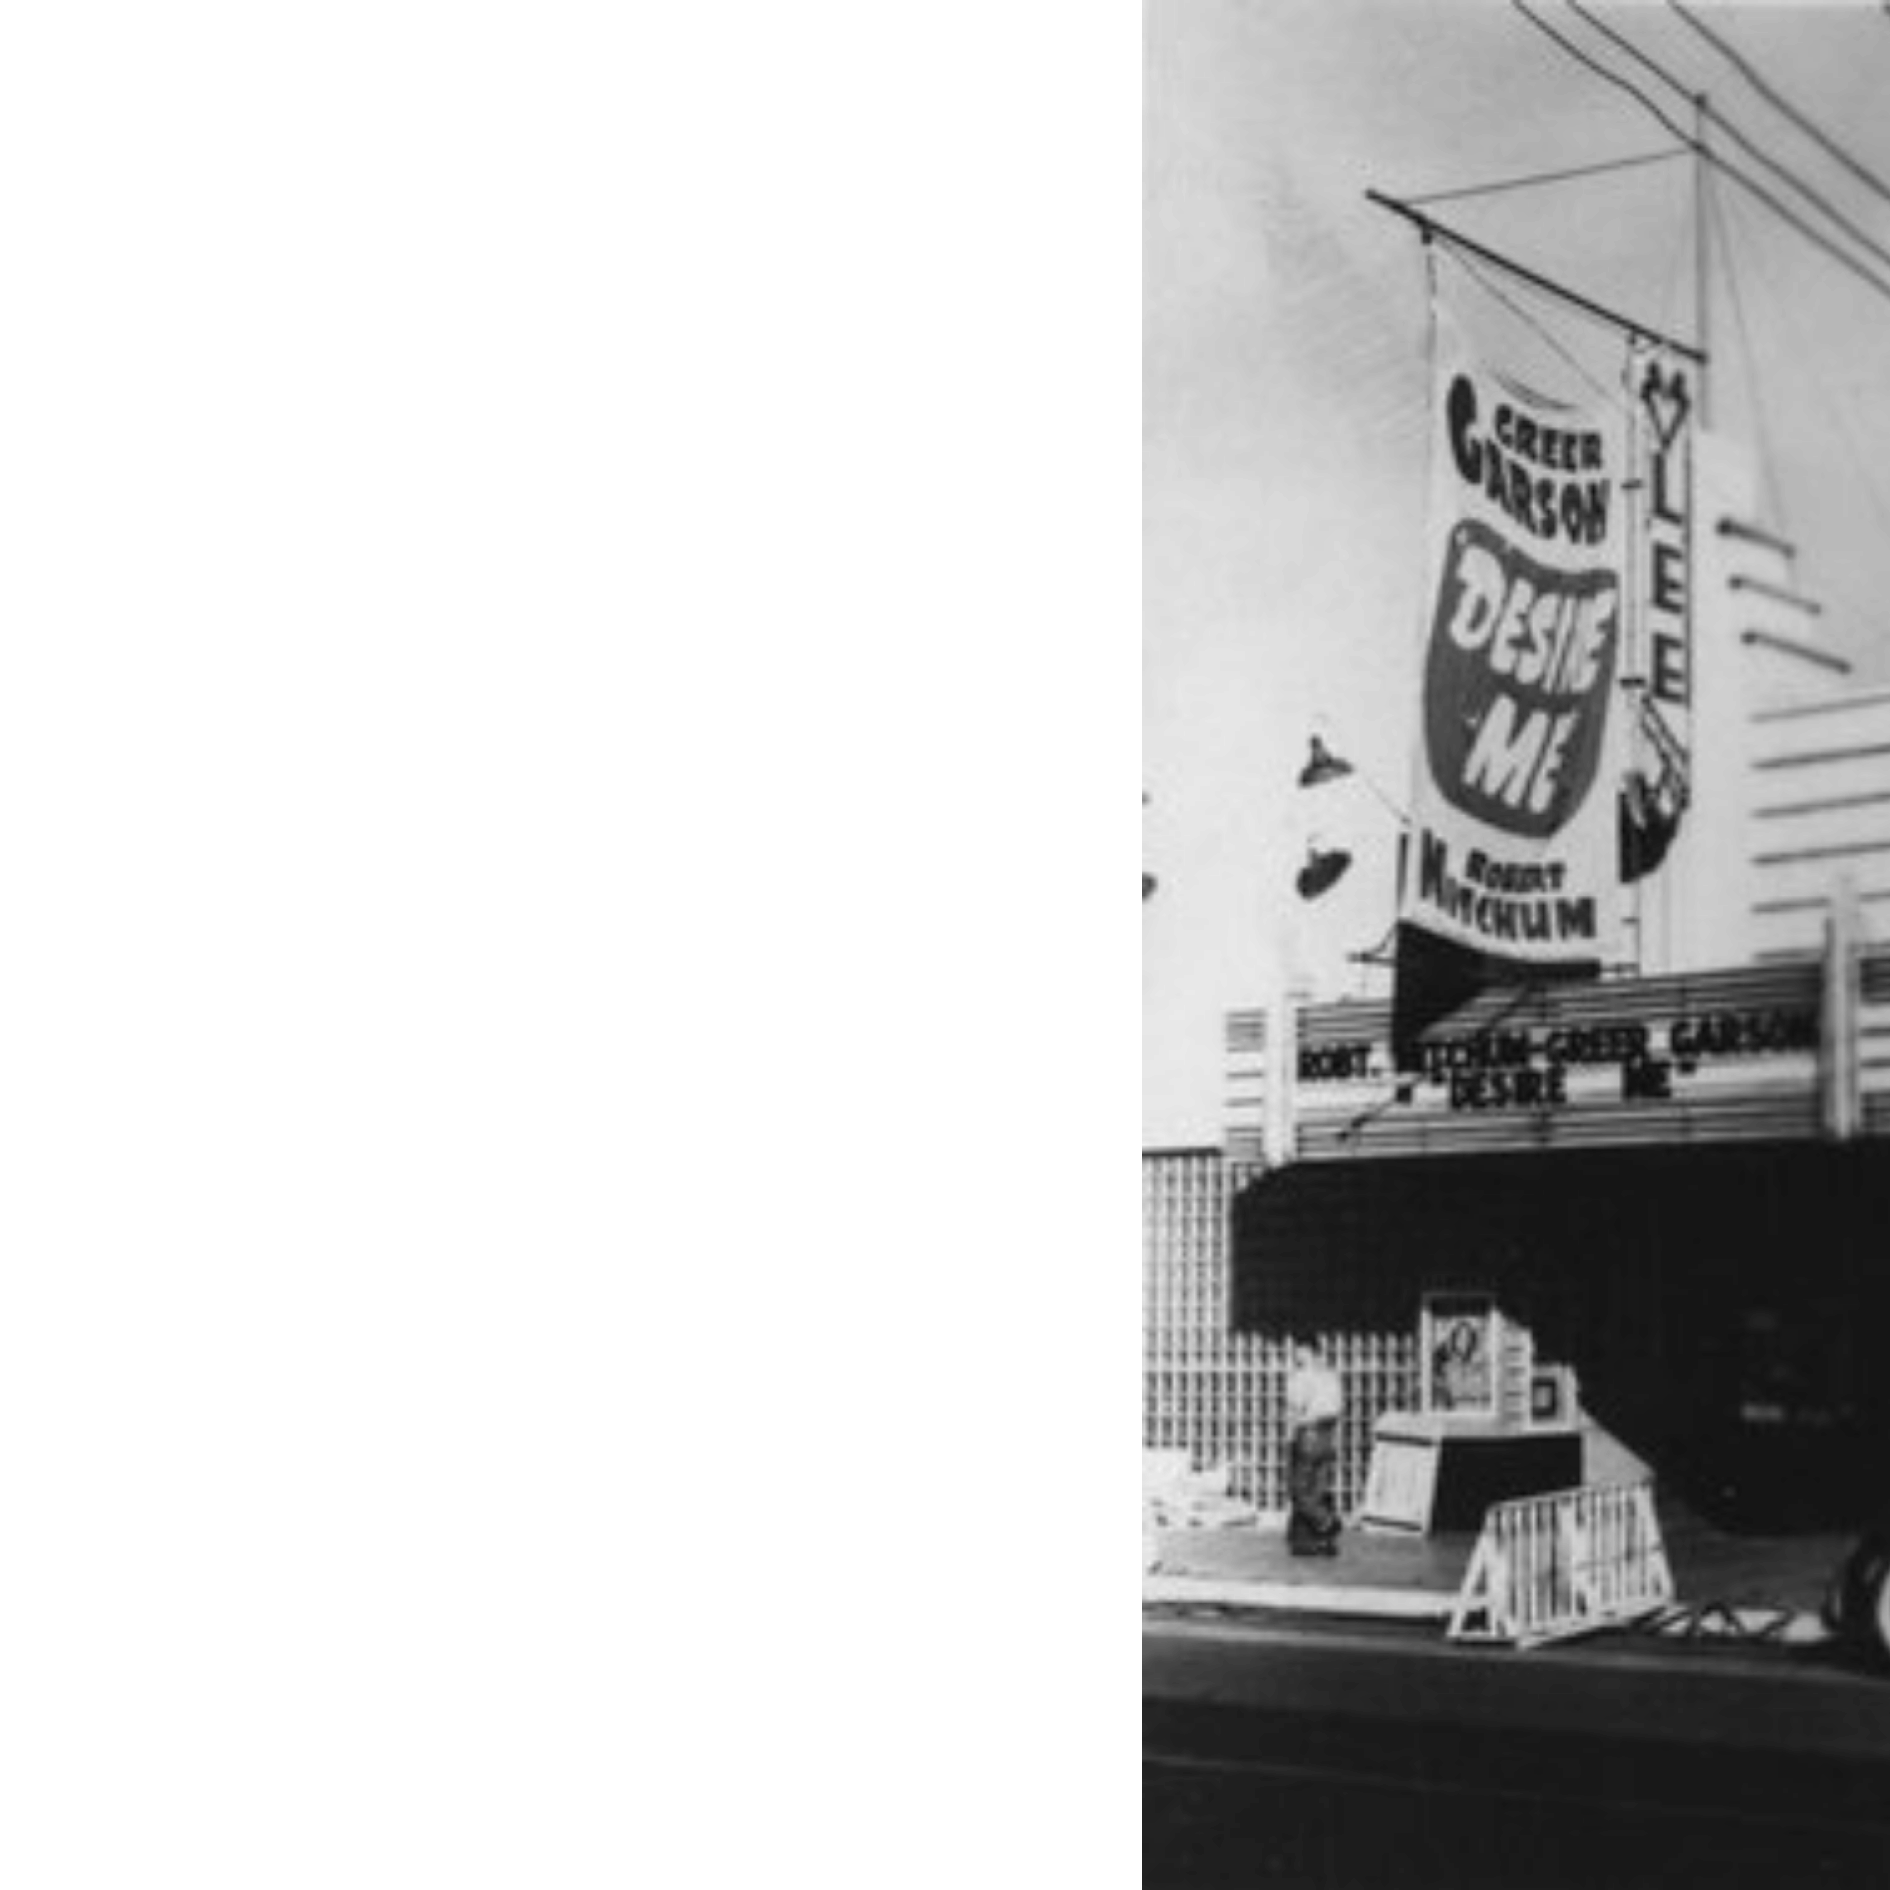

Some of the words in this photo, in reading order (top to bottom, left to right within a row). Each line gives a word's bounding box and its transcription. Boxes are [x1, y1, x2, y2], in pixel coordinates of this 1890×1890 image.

[1446, 373, 1611, 547] GARSON
[1496, 403, 1603, 474] GREER
[1462, 693, 1579, 813] ME
[1420, 828, 1597, 942] MITCHUM
[1466, 848, 1565, 891] ROBERT
